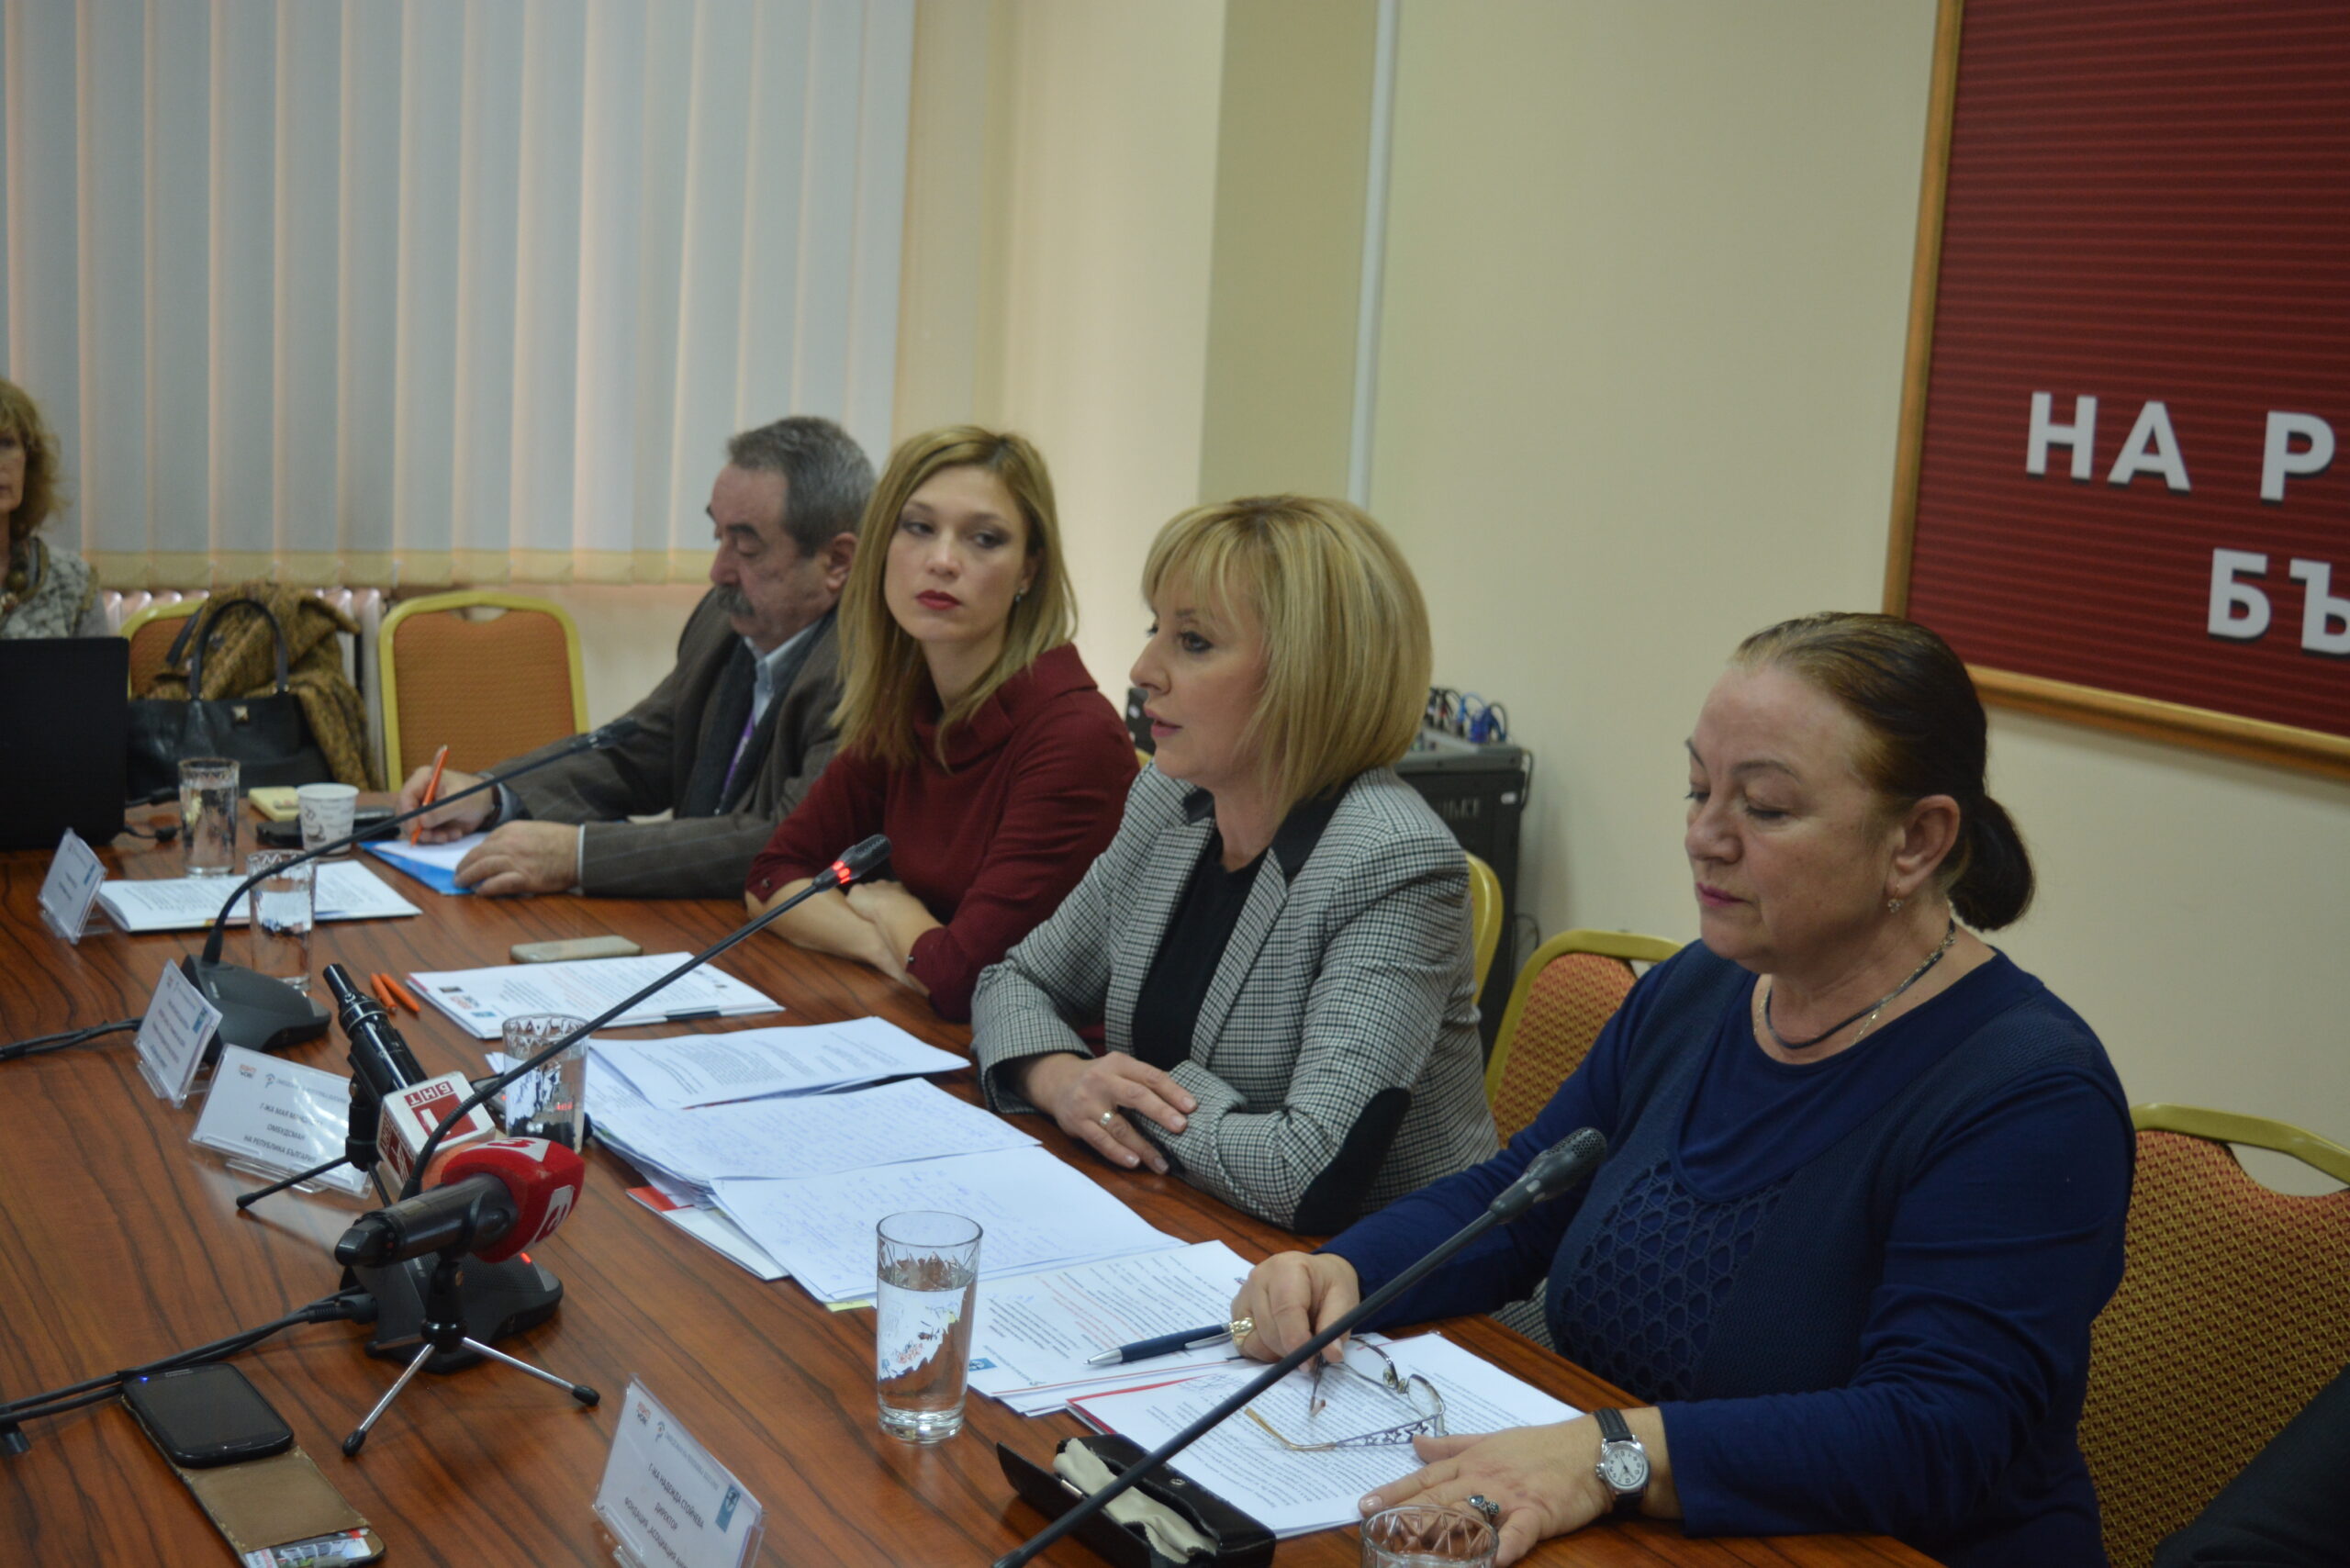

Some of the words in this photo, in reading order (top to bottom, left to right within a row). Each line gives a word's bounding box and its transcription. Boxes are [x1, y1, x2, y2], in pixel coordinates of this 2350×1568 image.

[2026, 391, 2192, 492] НА
[408, 1081, 453, 1107] БНТ
[252, 1136, 286, 1154] РЕПУБЛИКА
[655, 1502, 677, 1530] ДИРЕКТОР
[660, 1475, 682, 1506] НАДЕЖДА
[680, 1498, 704, 1529] СТОЙЧЕВА
